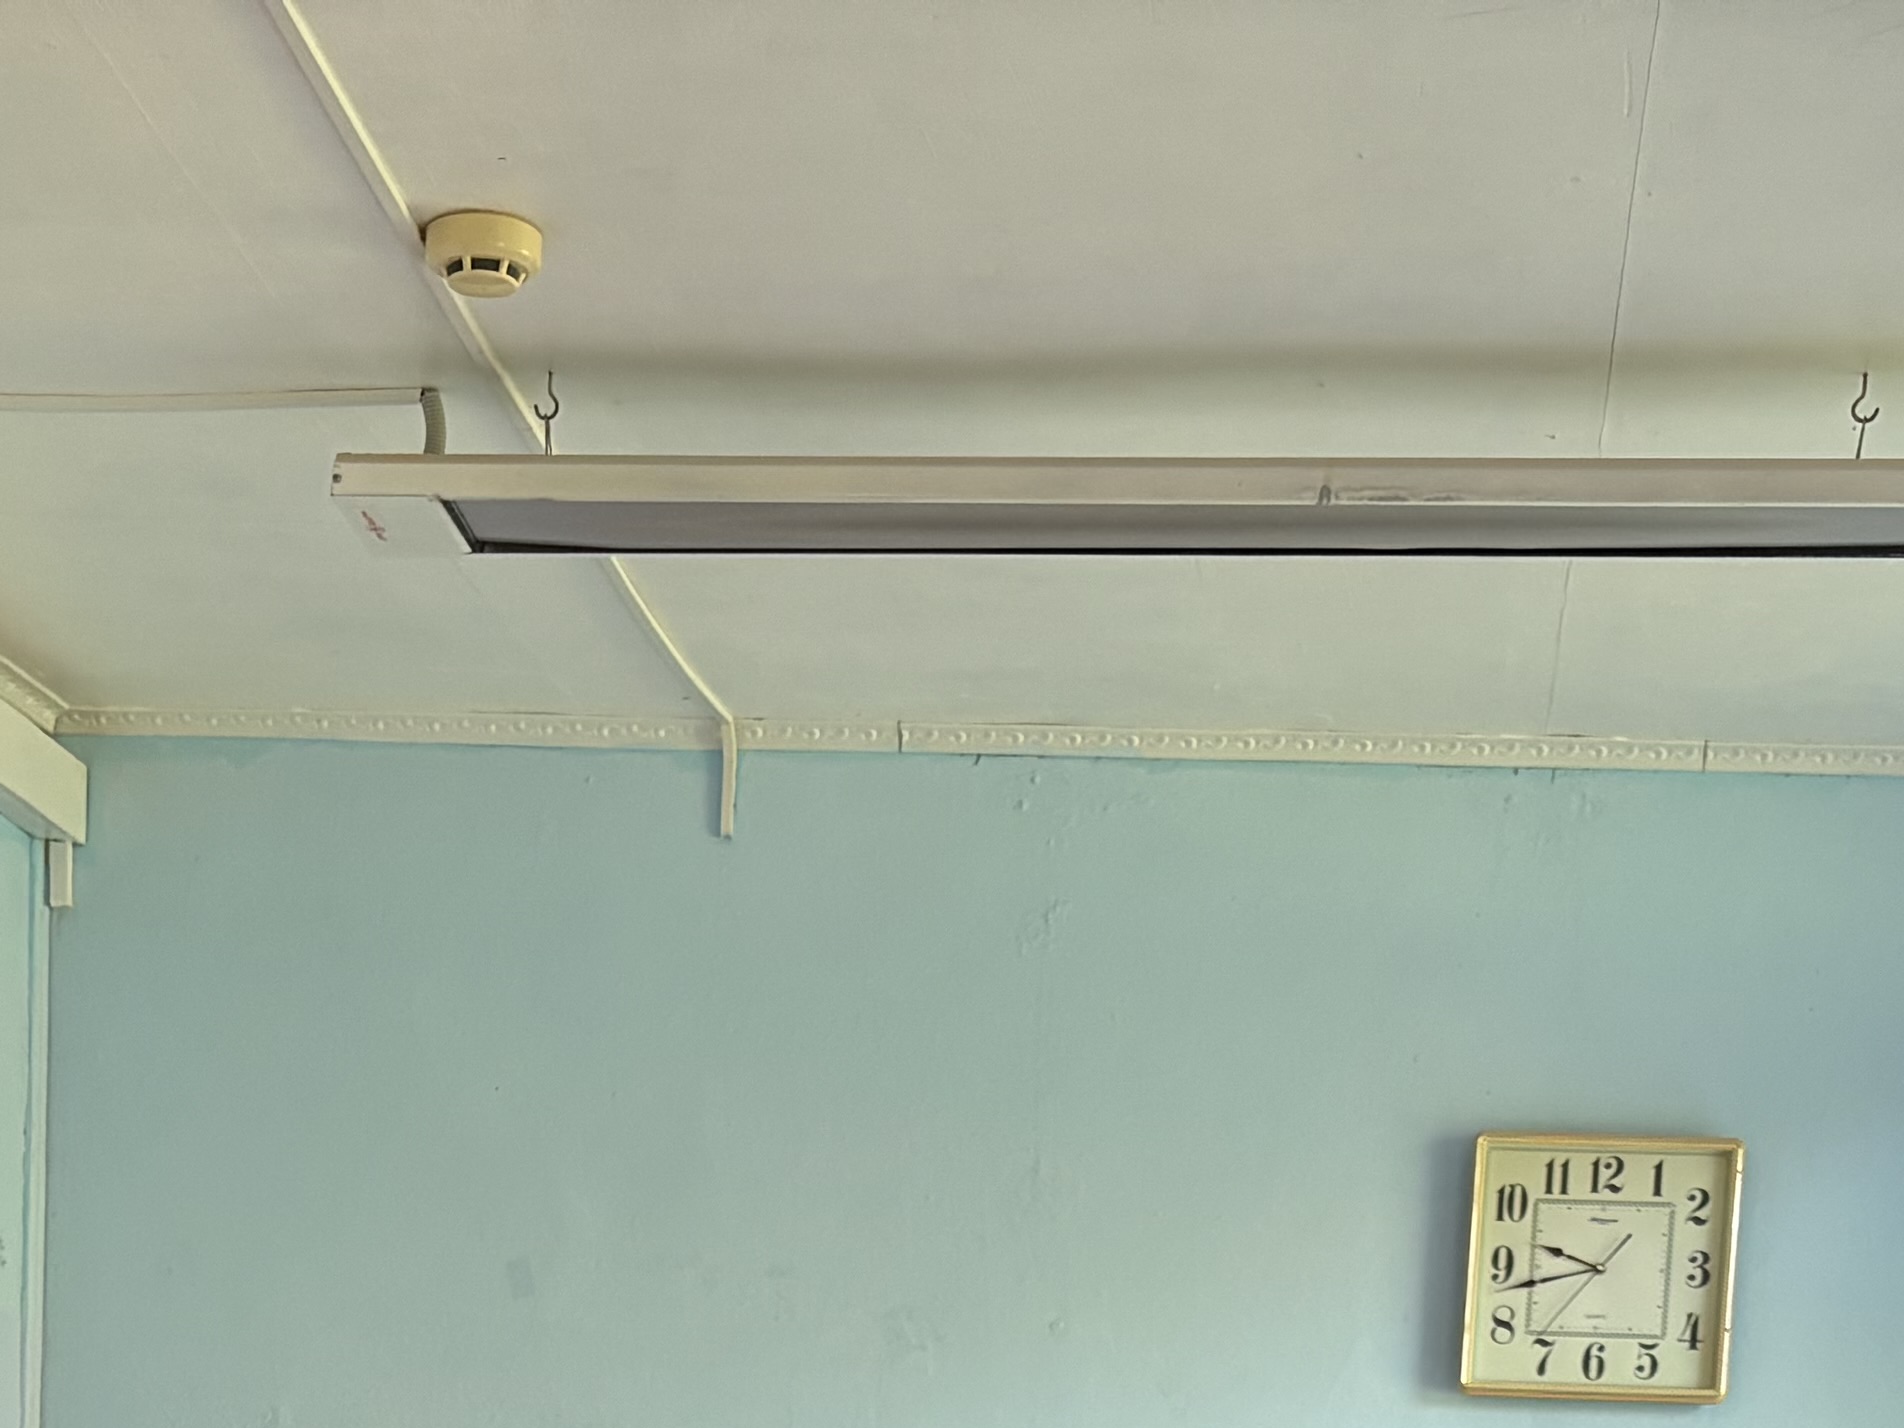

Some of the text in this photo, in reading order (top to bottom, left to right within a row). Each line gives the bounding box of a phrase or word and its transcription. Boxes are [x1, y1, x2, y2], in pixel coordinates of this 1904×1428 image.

[1544, 1157, 1570, 1195] 11
[1590, 1156, 1625, 1194] 12
[1653, 1160, 1664, 1197] 1
[1495, 1183, 1528, 1222] 10
[1686, 1188, 1710, 1226] 2
[1491, 1245, 1514, 1284] 9
[1685, 1250, 1710, 1288] 3
[1490, 1305, 1516, 1344] 8
[1677, 1312, 1704, 1350] 4
[1532, 1338, 1556, 1376] 7
[1582, 1342, 1605, 1381] 6
[1634, 1342, 1659, 1380] 5
